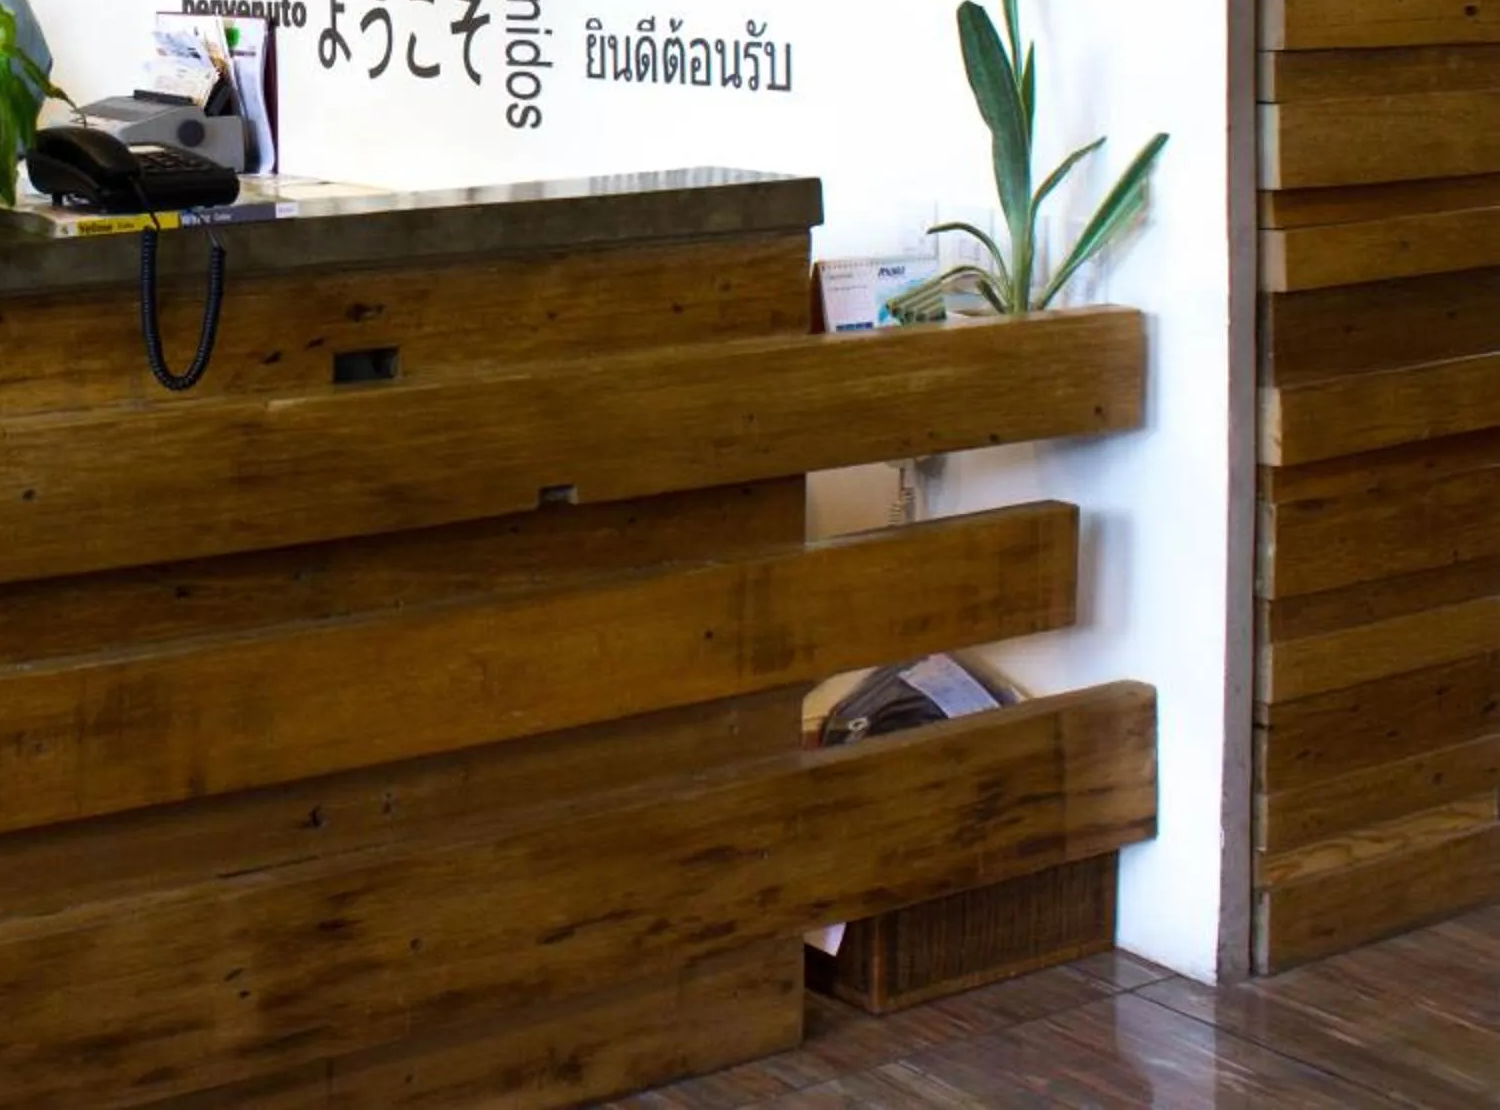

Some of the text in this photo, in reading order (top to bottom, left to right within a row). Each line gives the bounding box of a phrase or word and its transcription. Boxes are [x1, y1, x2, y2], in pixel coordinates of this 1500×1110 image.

[585, 15, 793, 93] ยินดีต้อนรับ
